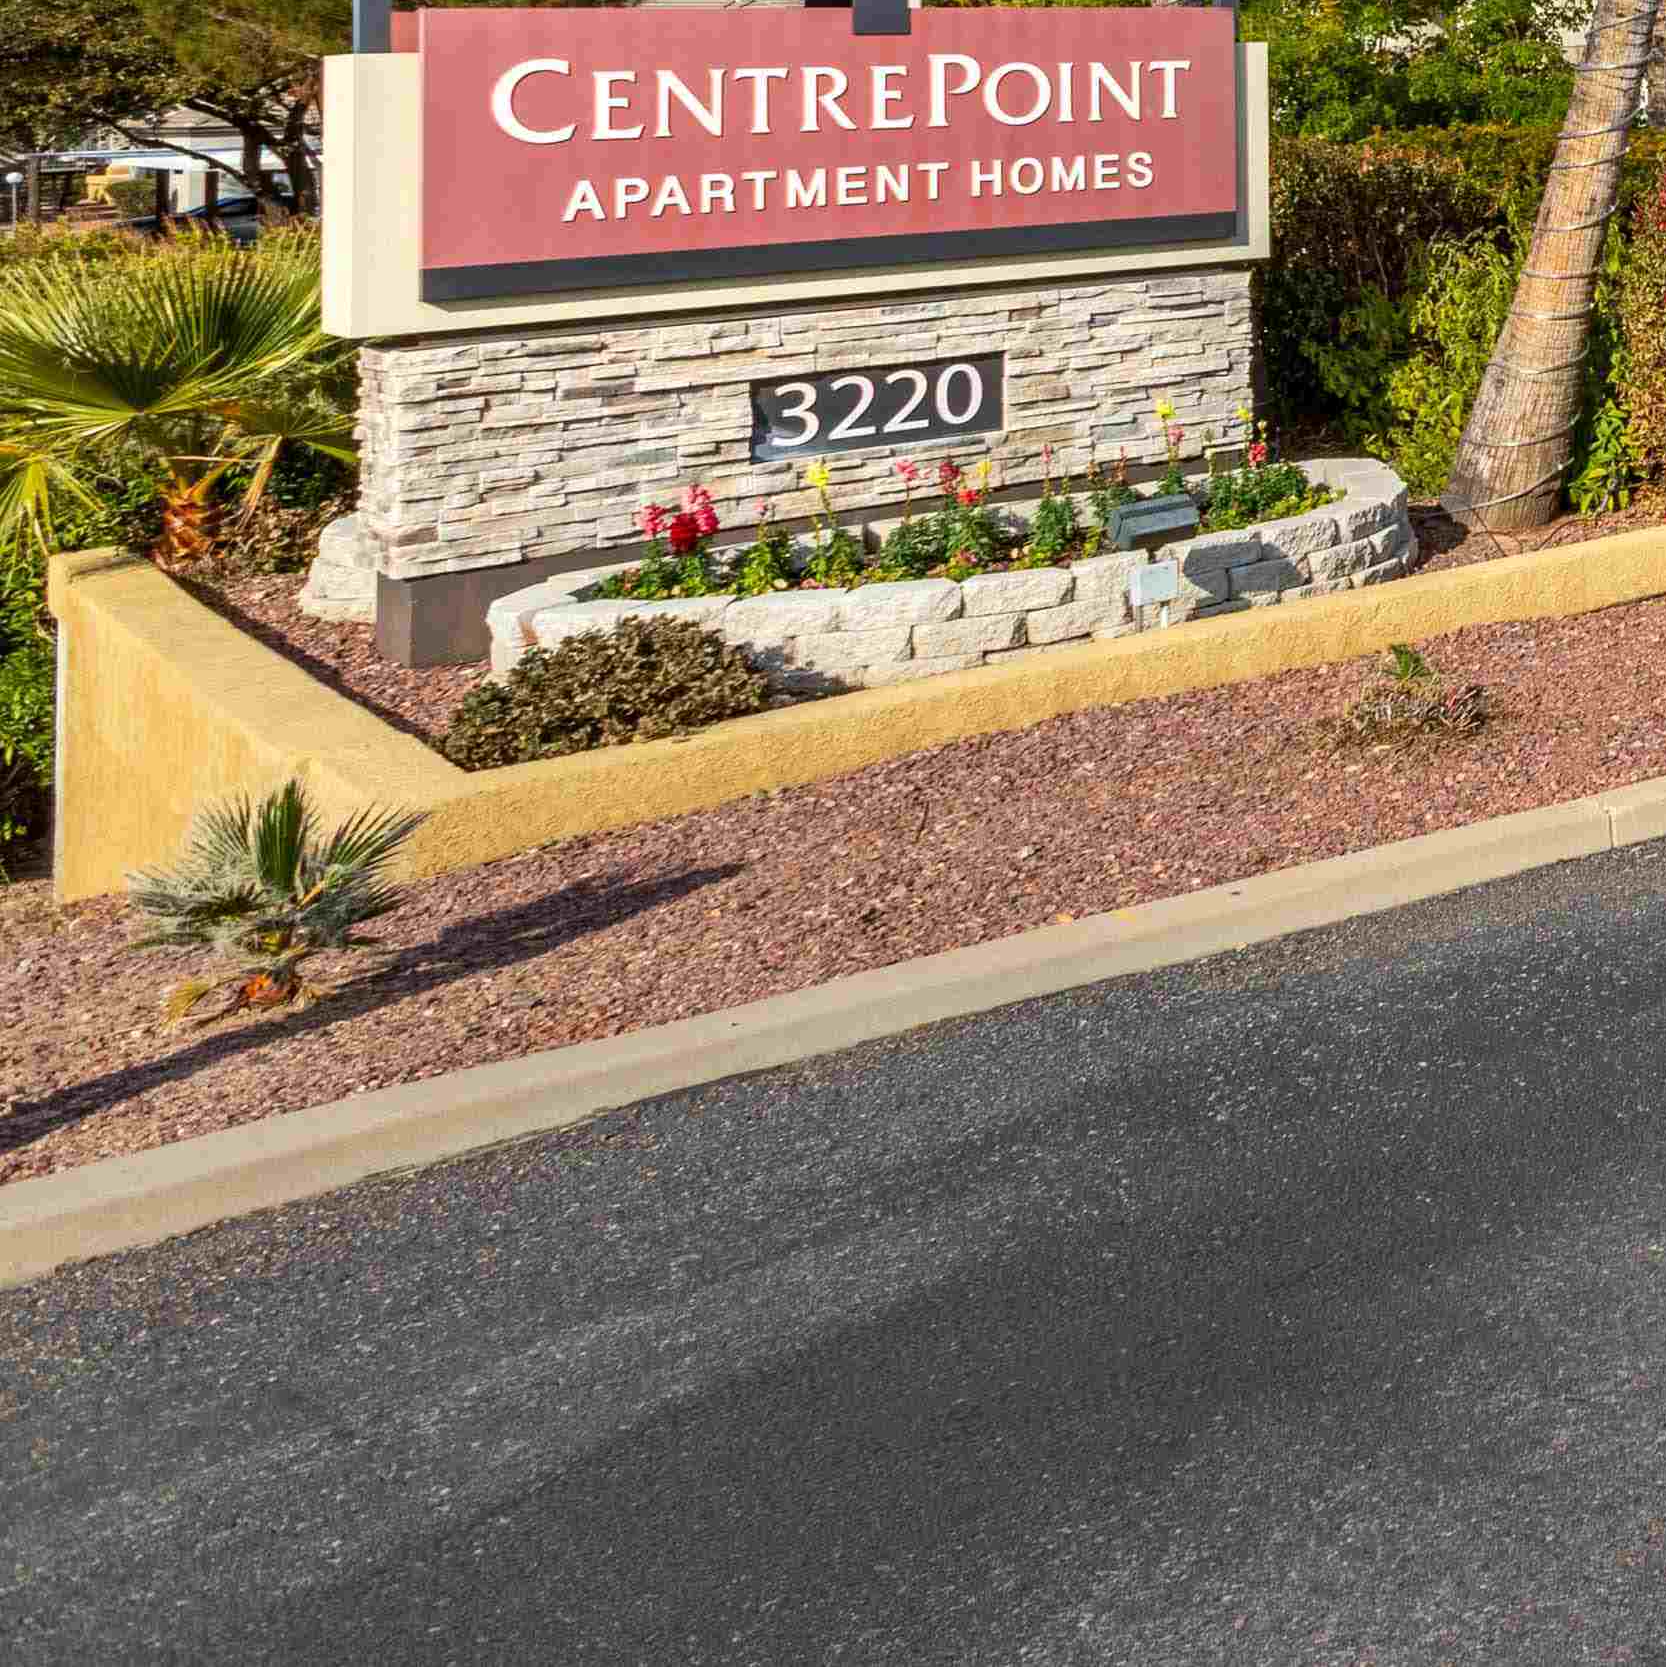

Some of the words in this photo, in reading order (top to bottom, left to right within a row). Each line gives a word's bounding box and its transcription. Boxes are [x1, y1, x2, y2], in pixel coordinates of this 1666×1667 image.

[490, 53, 1192, 145] CENTREPOINT
[561, 162, 950, 222] APARTMENT
[969, 151, 1154, 198] HOMES
[770, 362, 983, 447] 3220
